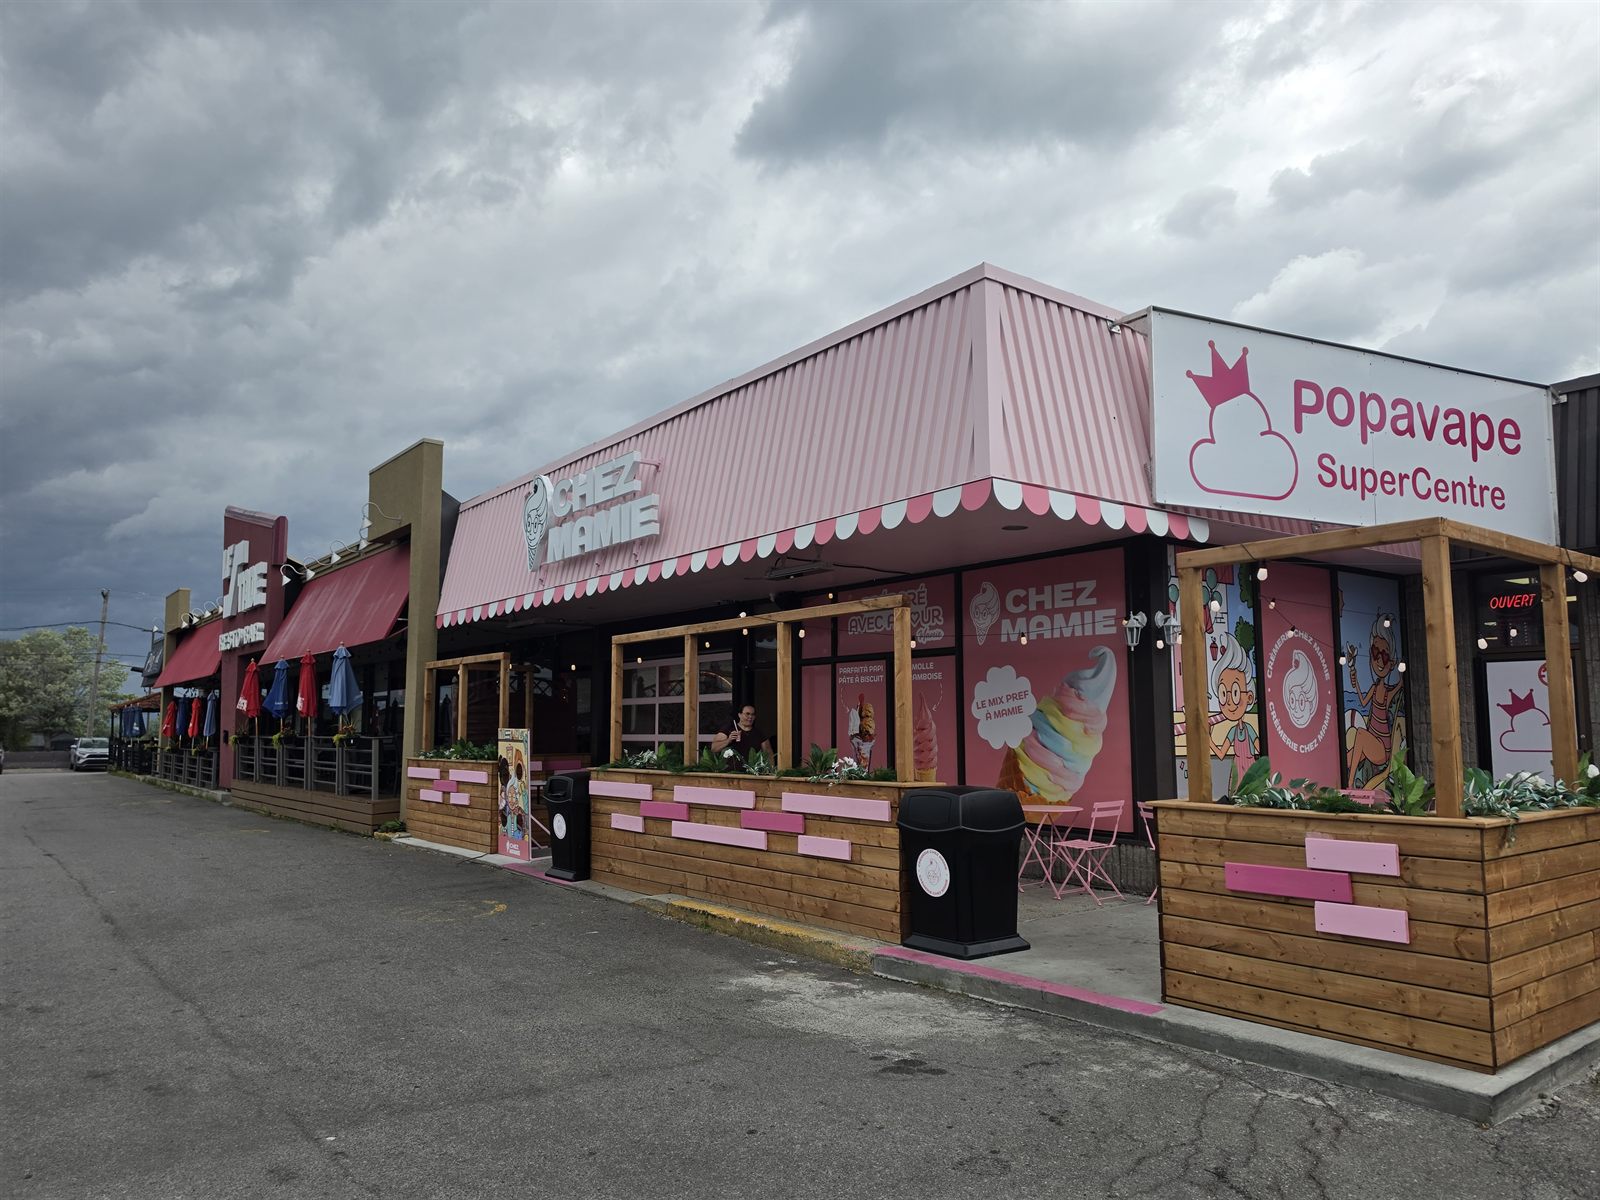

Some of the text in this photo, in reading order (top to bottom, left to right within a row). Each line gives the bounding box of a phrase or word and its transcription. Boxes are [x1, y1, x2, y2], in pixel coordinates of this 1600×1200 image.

[1293, 379, 1521, 463] Popavape
[552, 451, 641, 517] CHEZ
[1317, 452, 1506, 510] SuperCentre
[547, 494, 660, 563] MAMIE
[1005, 580, 1097, 614] CHEZ
[1489, 593, 1536, 609] OUVERT
[848, 615, 883, 633] AVEC
[1001, 608, 1117, 643] MAMIE
[869, 664, 884, 672] PAPI
[1294, 628, 1313, 645] CHEZ
[1312, 642, 1331, 681] MAMIE
[860, 675, 884, 683] BISCUIT
[976, 690, 1030, 710] LE MIX PREF
[985, 705, 1024, 721] À MAMIE
[1299, 738, 1319, 753] CHEZ
[1318, 703, 1332, 743] MAMIE
